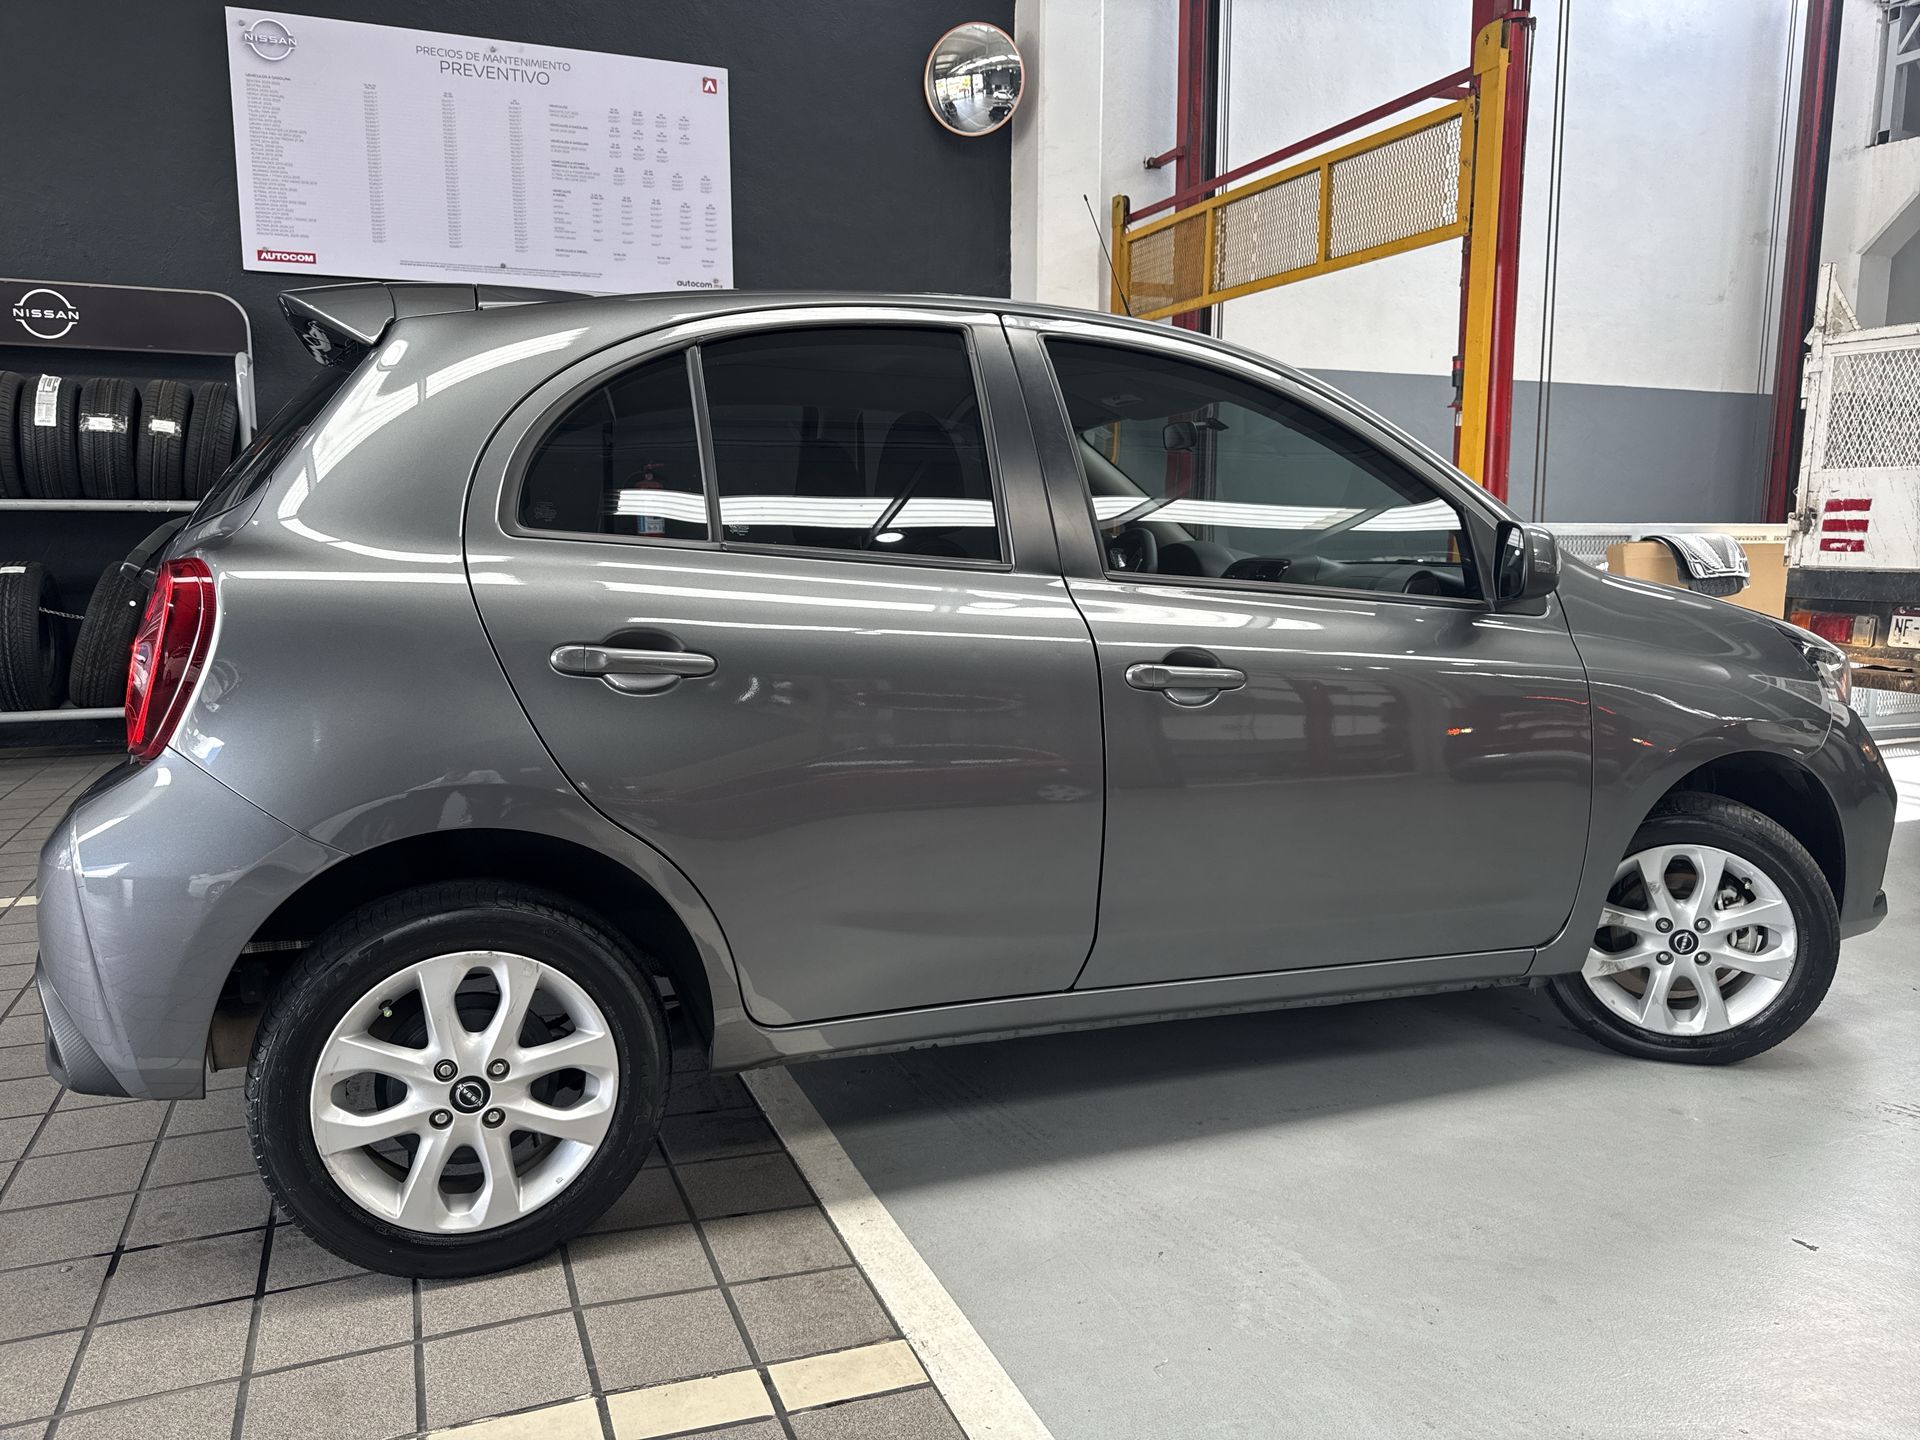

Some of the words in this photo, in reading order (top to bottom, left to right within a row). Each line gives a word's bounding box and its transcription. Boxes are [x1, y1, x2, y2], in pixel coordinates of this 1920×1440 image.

[244, 32, 297, 46] NISSAN
[415, 45, 463, 59] PRECIOS
[466, 51, 480, 62] DE
[483, 53, 571, 72] MANTENIMIENTO
[439, 60, 550, 86] PREVENTIVO
[260, 251, 315, 263] AUTOCOM
[12, 307, 80, 320] NISSAN
